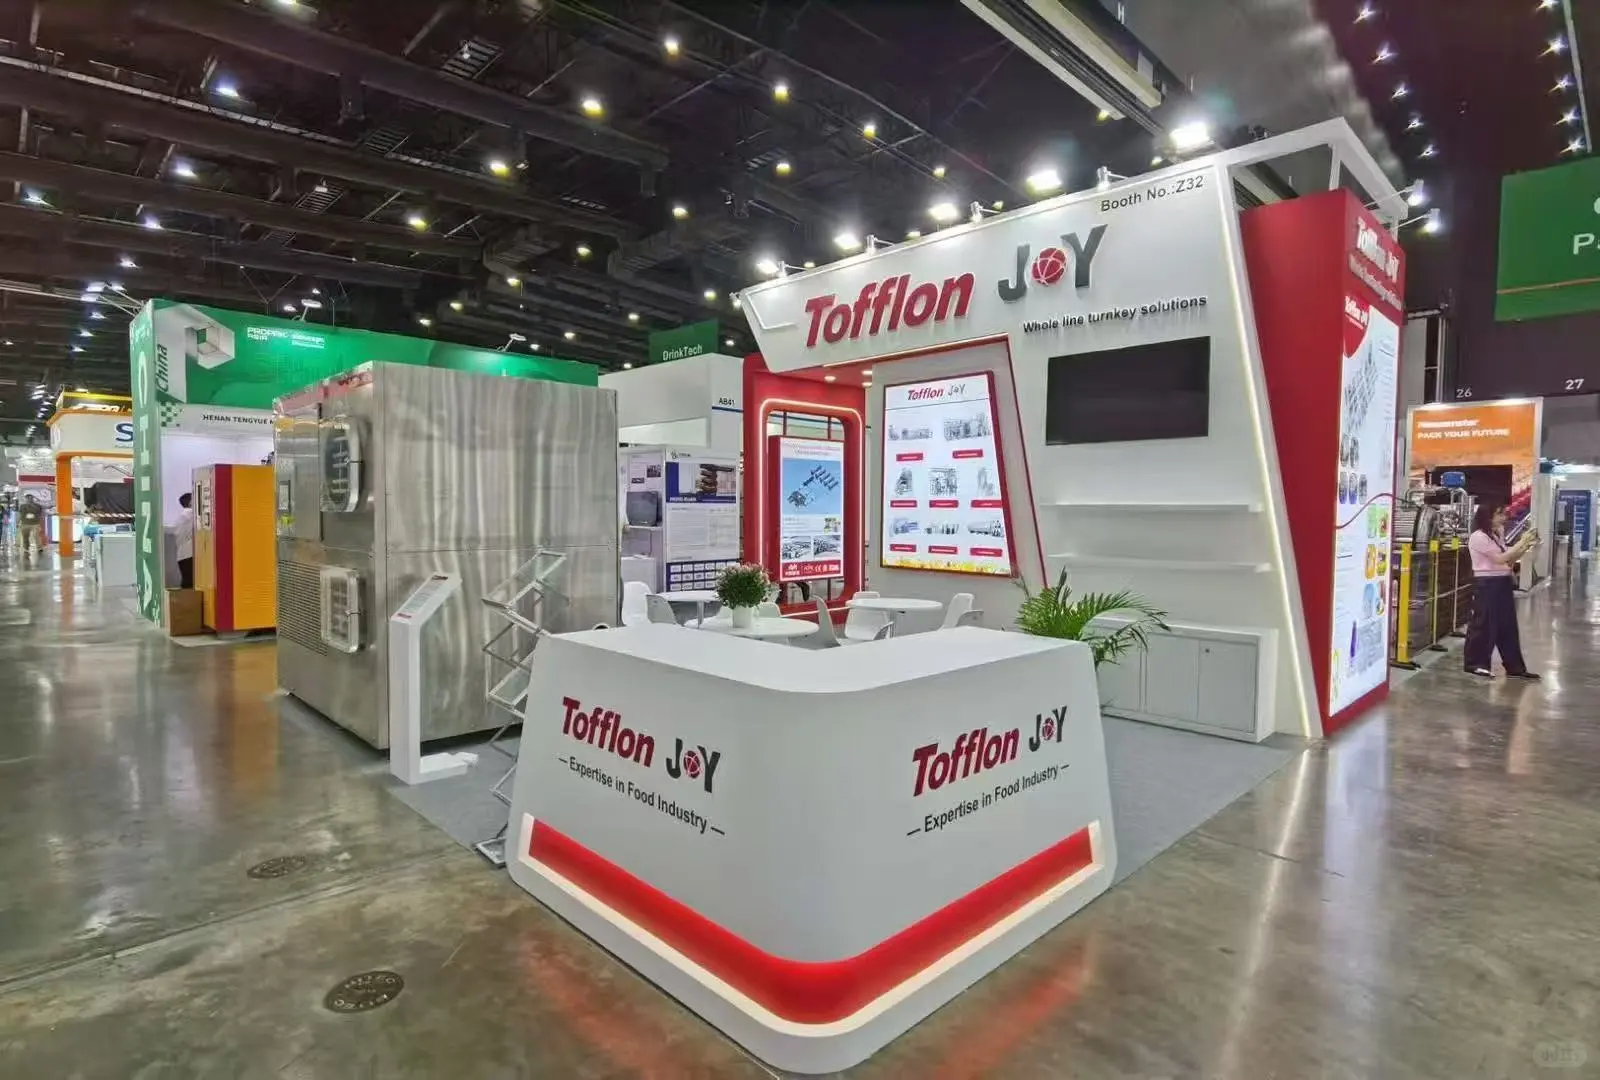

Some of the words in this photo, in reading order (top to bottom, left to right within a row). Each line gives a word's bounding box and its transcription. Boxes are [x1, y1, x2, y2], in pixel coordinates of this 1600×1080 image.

[1101, 192, 1142, 212] Booth
[804, 272, 975, 347] Tofflon
[1023, 318, 1059, 334] Whole
[1062, 314, 1084, 327] line
[1088, 306, 1137, 324] turnkey
[1140, 295, 1207, 316] solutions
[155, 343, 169, 392] China
[662, 343, 703, 361] DrinkTech
[908, 387, 944, 401] Tofflon
[1456, 388, 1472, 399] 26
[1565, 379, 1584, 391] 27
[203, 414, 231, 422] HENAN
[562, 696, 655, 768] Tofflon
[912, 727, 1020, 797] Tofflon
[570, 756, 613, 788] Expertise
[615, 776, 625, 793] in
[628, 781, 654, 806] Food
[658, 795, 708, 834] Industry
[924, 799, 979, 832] Expertise
[982, 792, 992, 808] in
[994, 780, 1020, 801] Food
[1022, 765, 1058, 790] Industry
